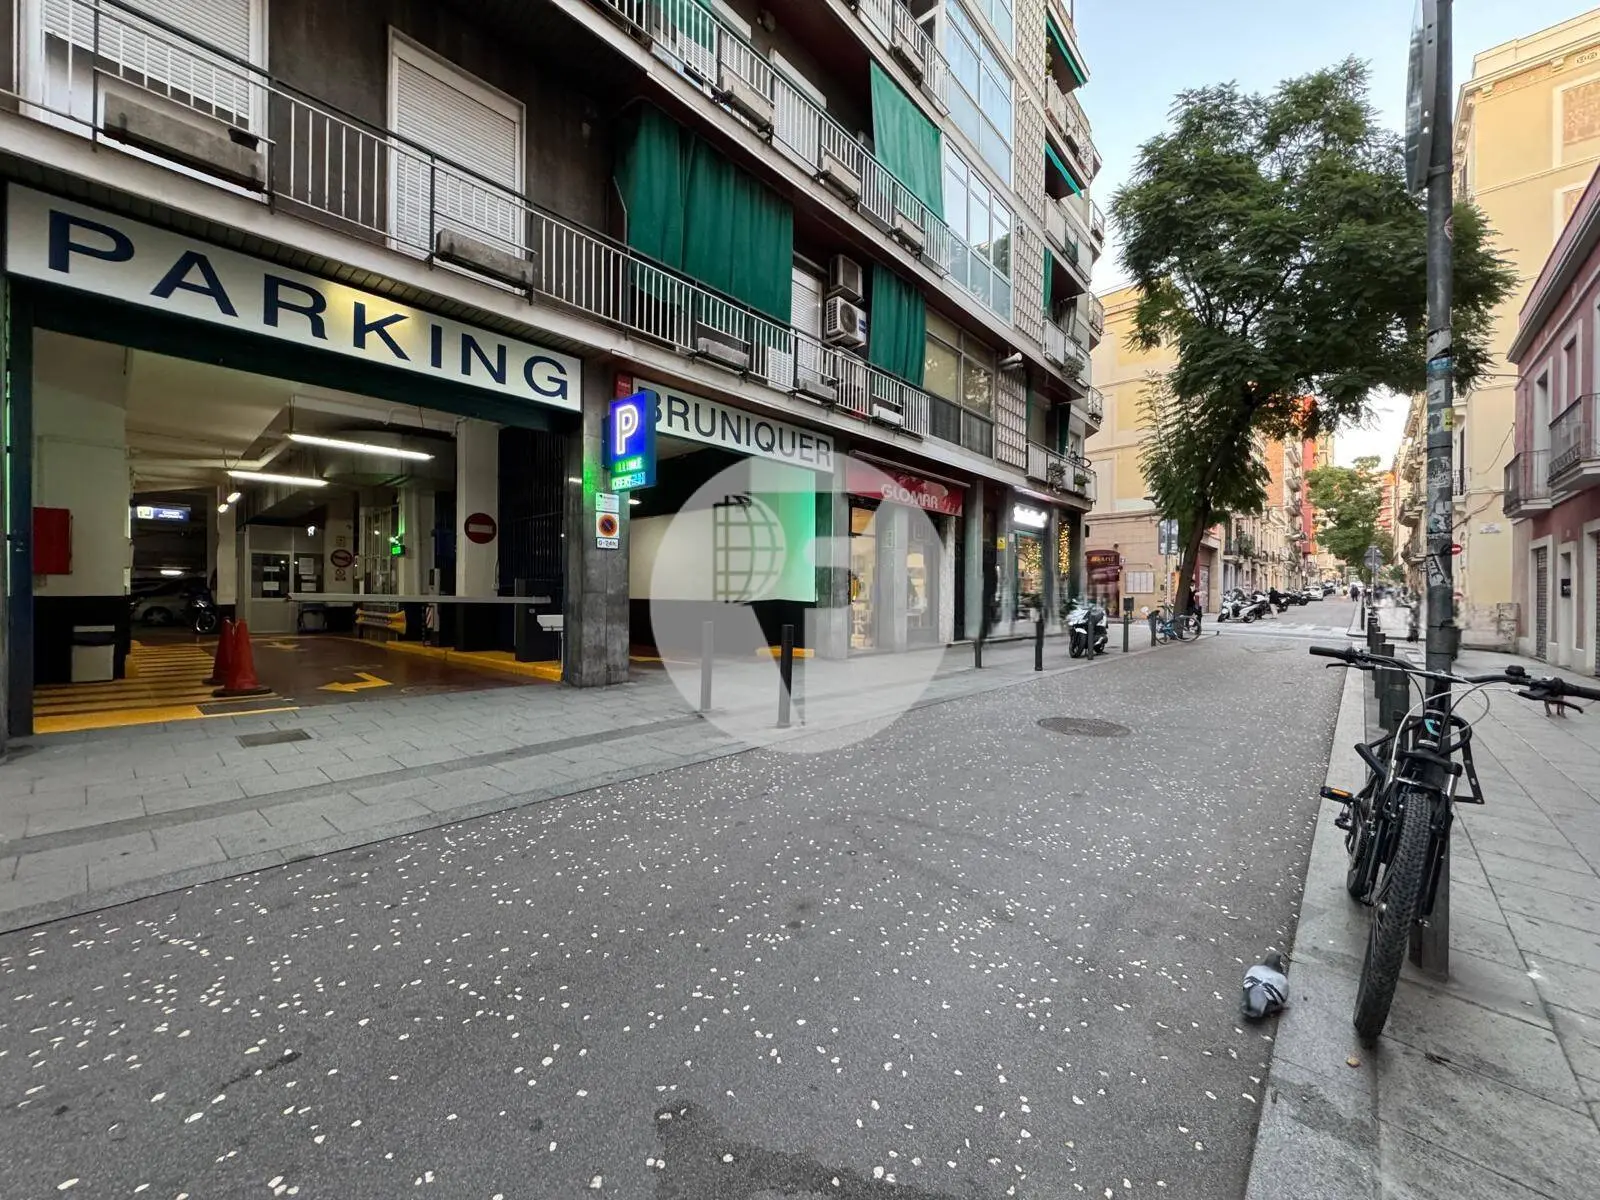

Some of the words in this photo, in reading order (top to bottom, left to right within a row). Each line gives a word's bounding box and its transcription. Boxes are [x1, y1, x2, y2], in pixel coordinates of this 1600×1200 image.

[49, 209, 569, 401] PARKING
[616, 404, 639, 455] P
[881, 483, 938, 508] GLOMAR
